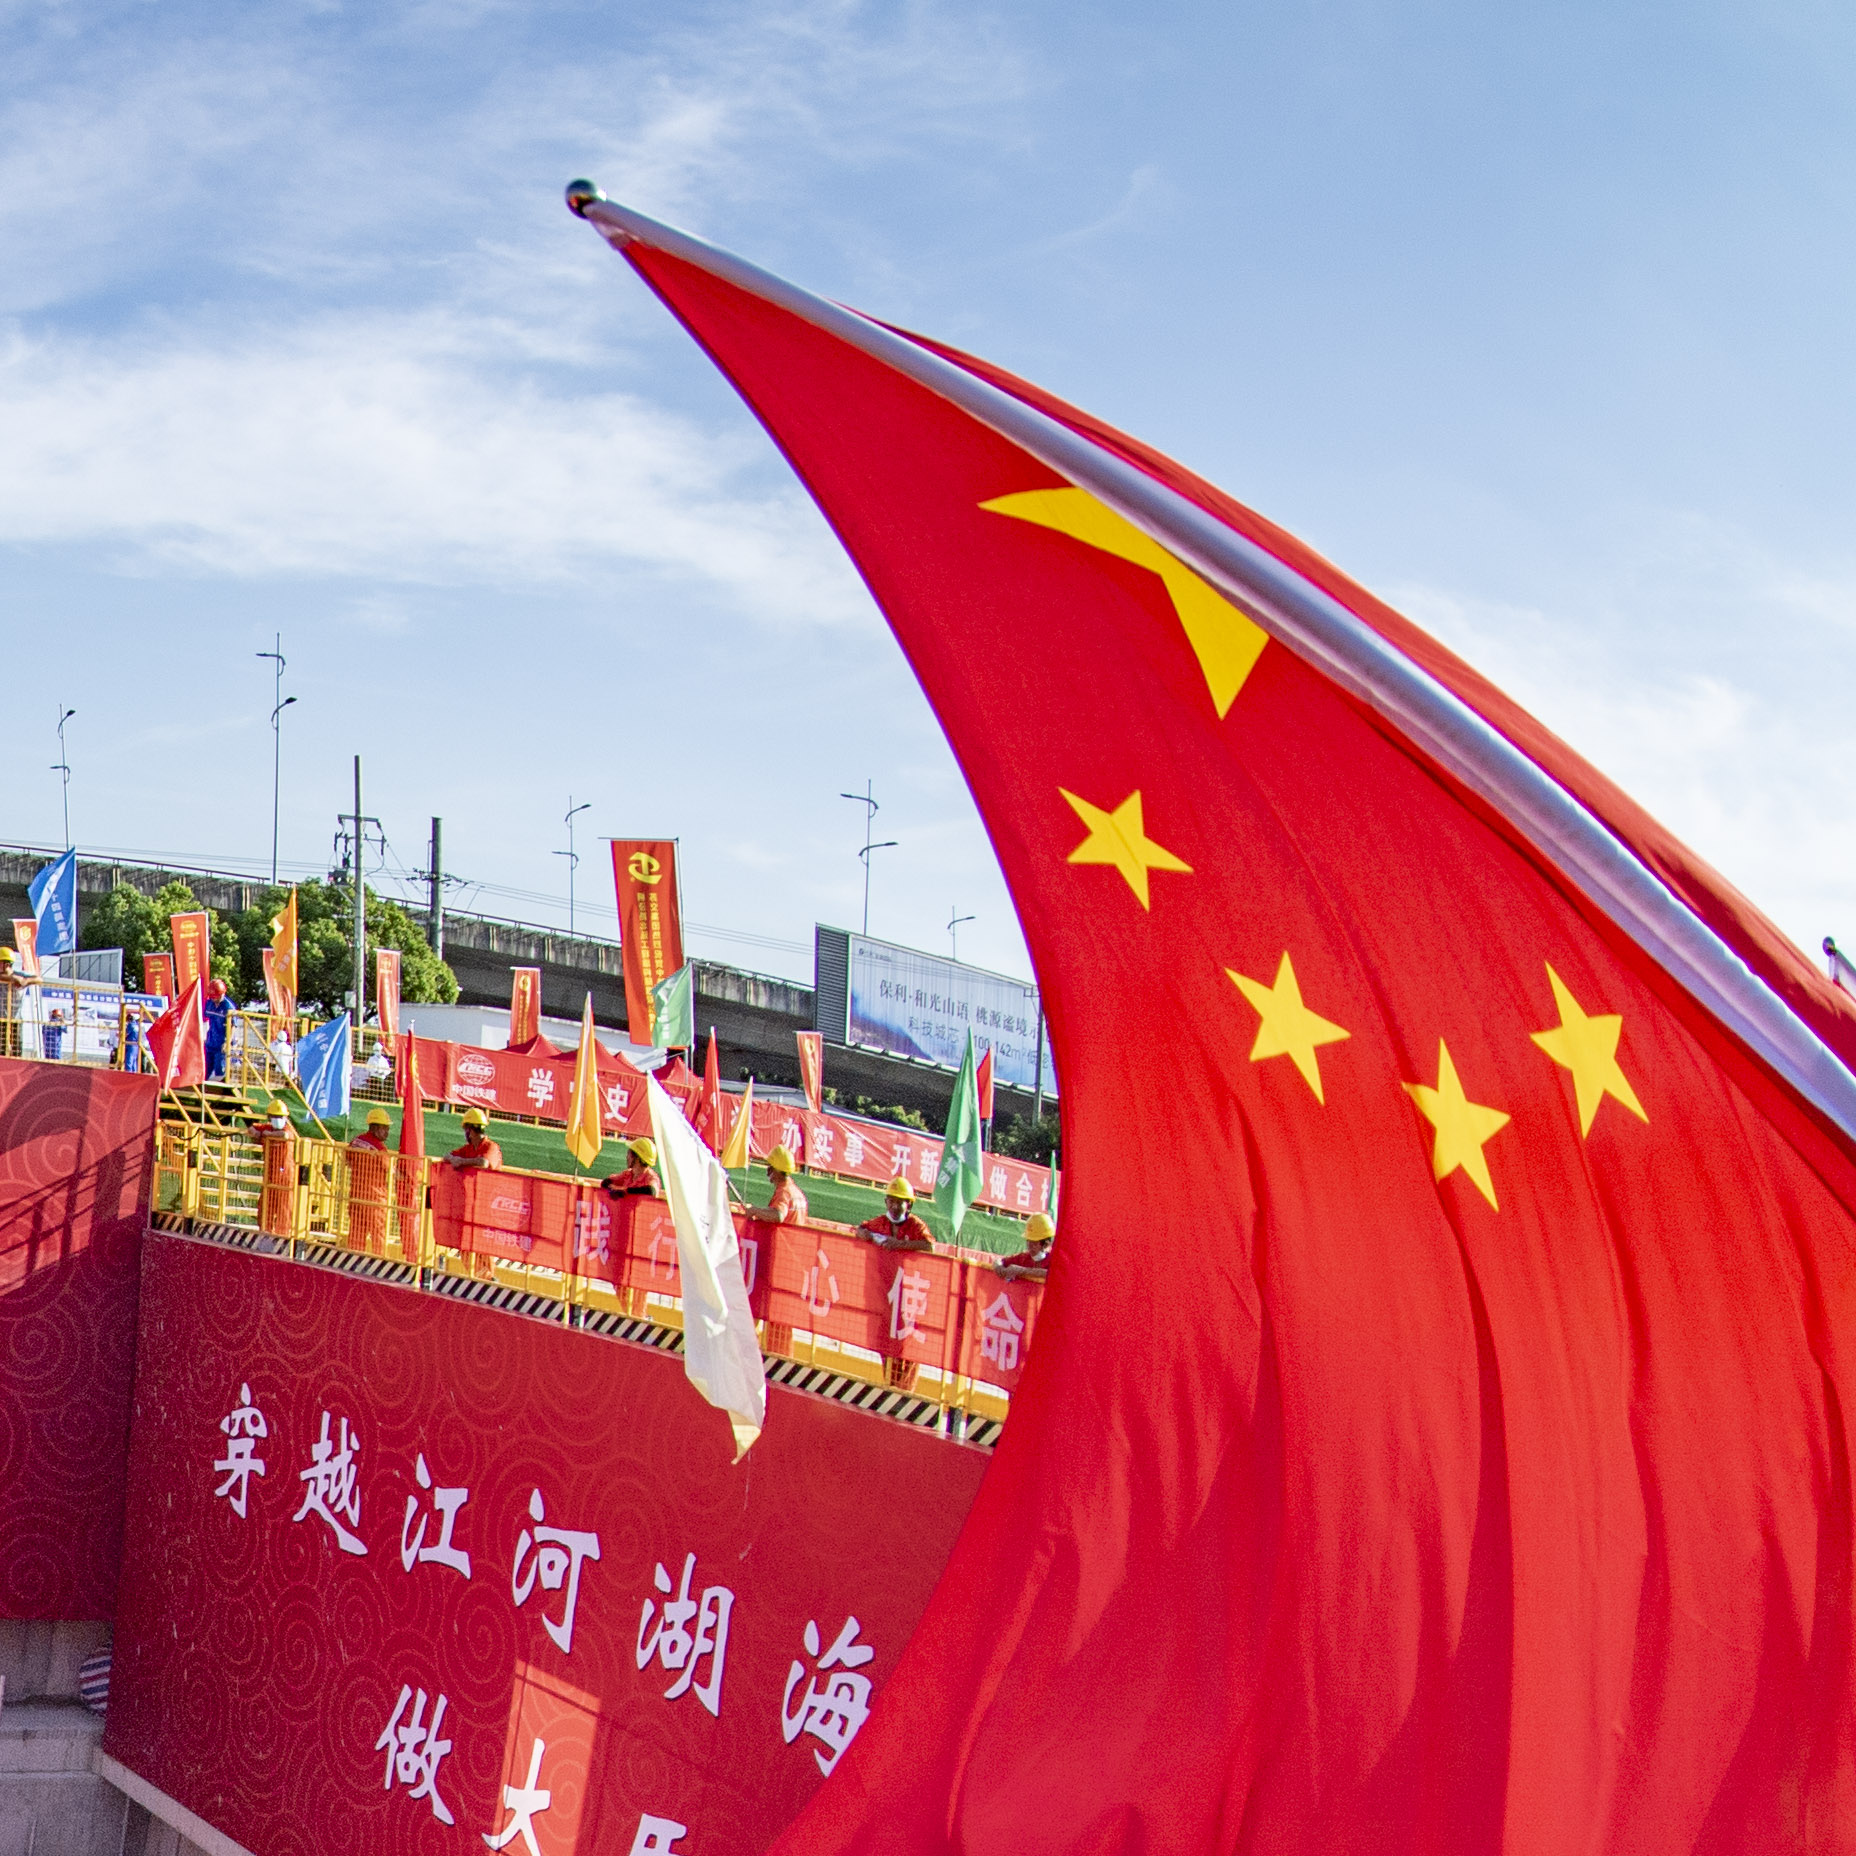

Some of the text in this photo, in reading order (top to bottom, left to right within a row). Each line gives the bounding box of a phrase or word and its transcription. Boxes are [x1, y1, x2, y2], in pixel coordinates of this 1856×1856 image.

[451, 1084, 497, 1101] 中国铁建
[527, 1068, 630, 1125] 学史
[214, 1382, 873, 1778] 穿越江河湖海
